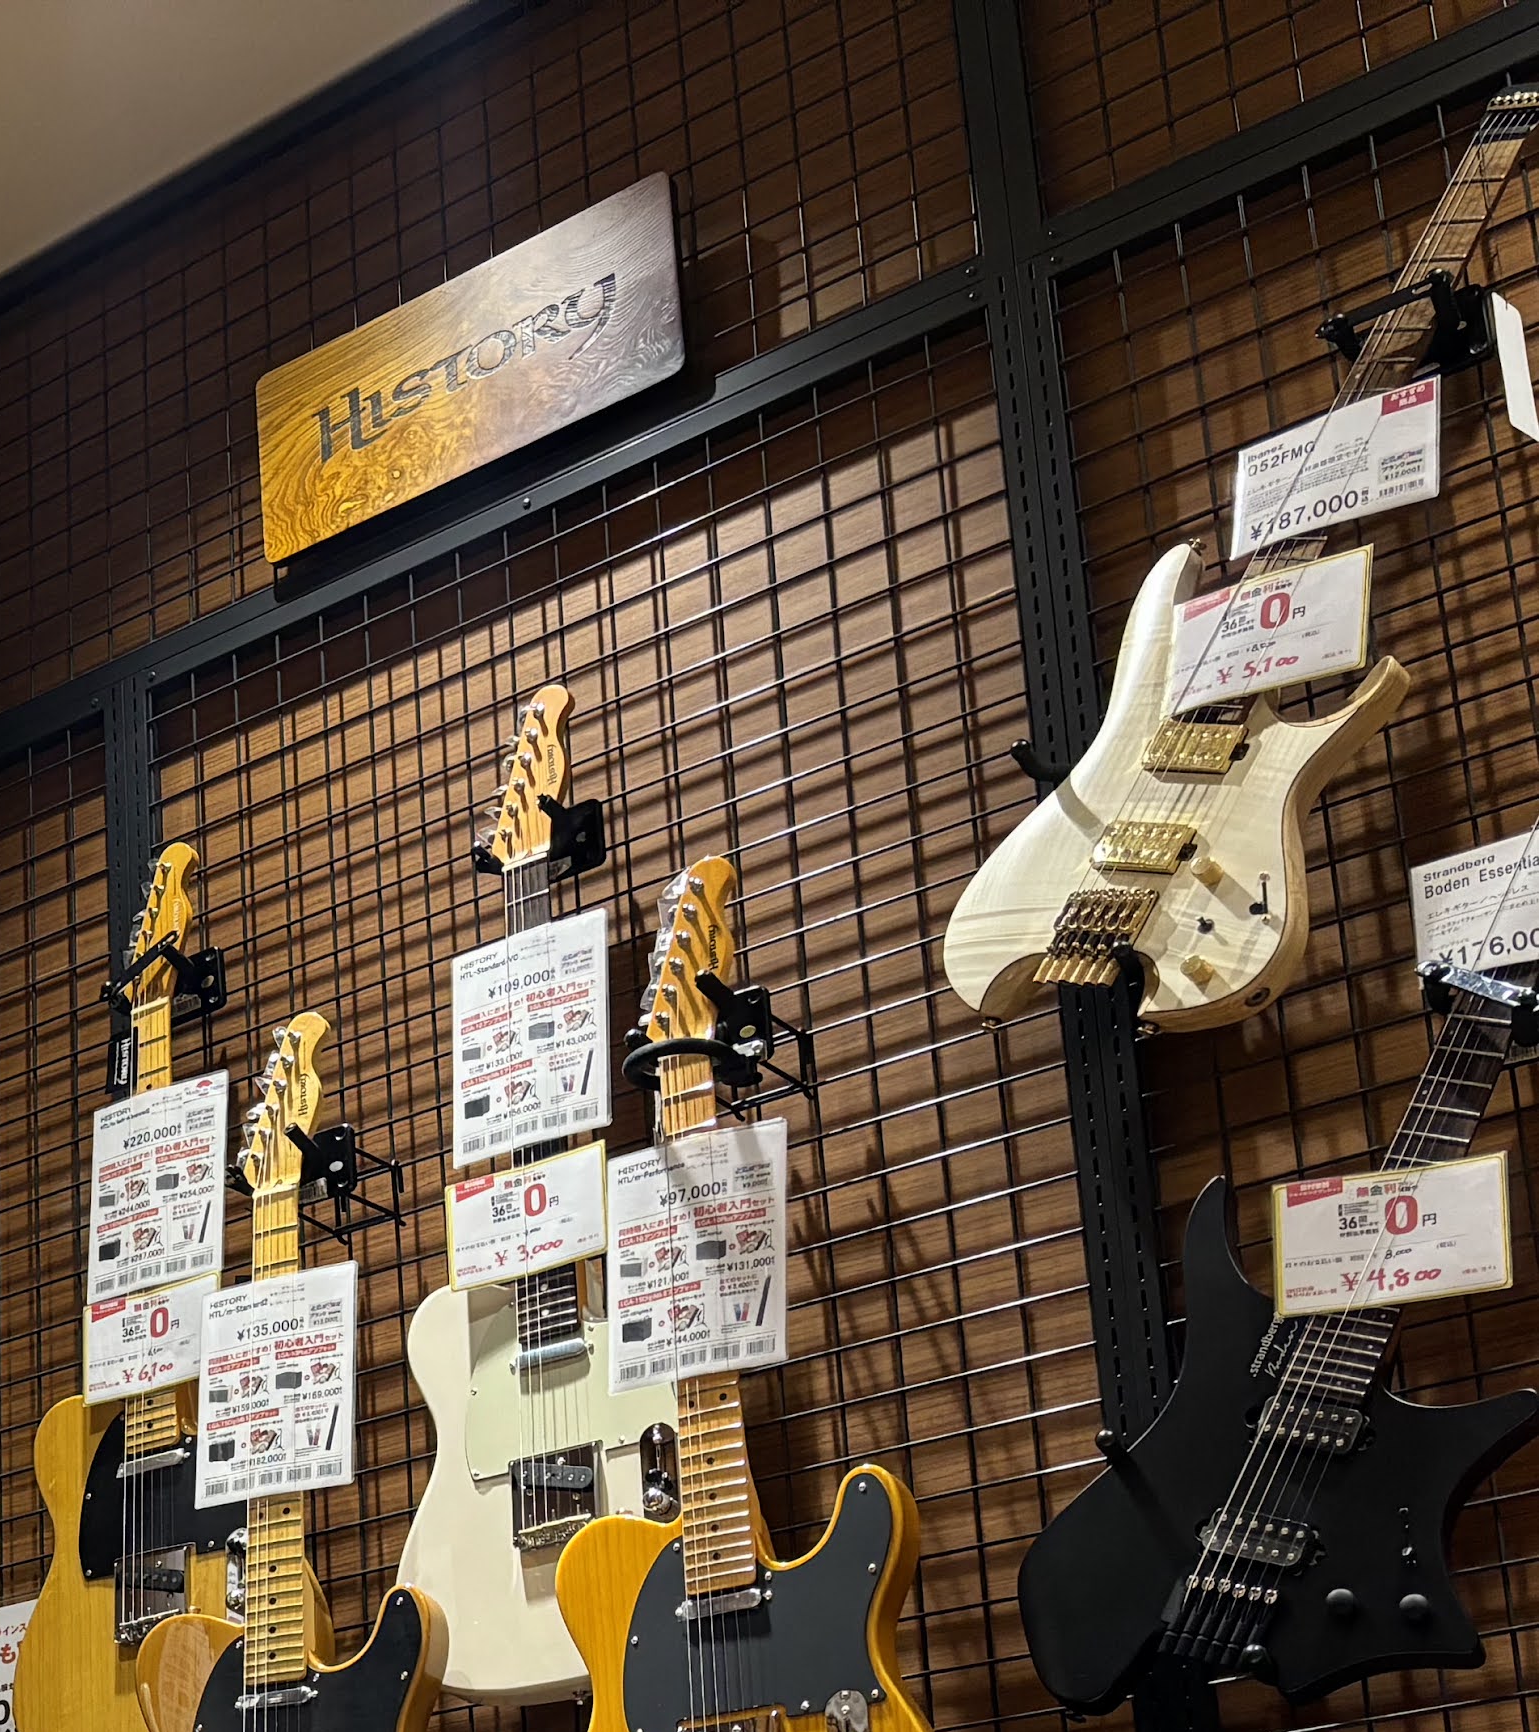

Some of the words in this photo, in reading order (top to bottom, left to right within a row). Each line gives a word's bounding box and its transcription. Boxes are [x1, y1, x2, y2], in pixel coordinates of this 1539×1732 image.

[312, 273, 616, 464] HISTORY
[1247, 443, 1285, 465] Ibanez
[1250, 489, 1359, 541] ¥187,000
[1423, 854, 1496, 882] Strandberg
[1424, 877, 1470, 899] Boden
[488, 969, 551, 999] ¥109,000
[123, 1124, 177, 1150] ¥220,000
[659, 1181, 722, 1208] ¥97,000
[727, 1256, 774, 1272] ¥131,000
[237, 1318, 299, 1342] ¥135,000
